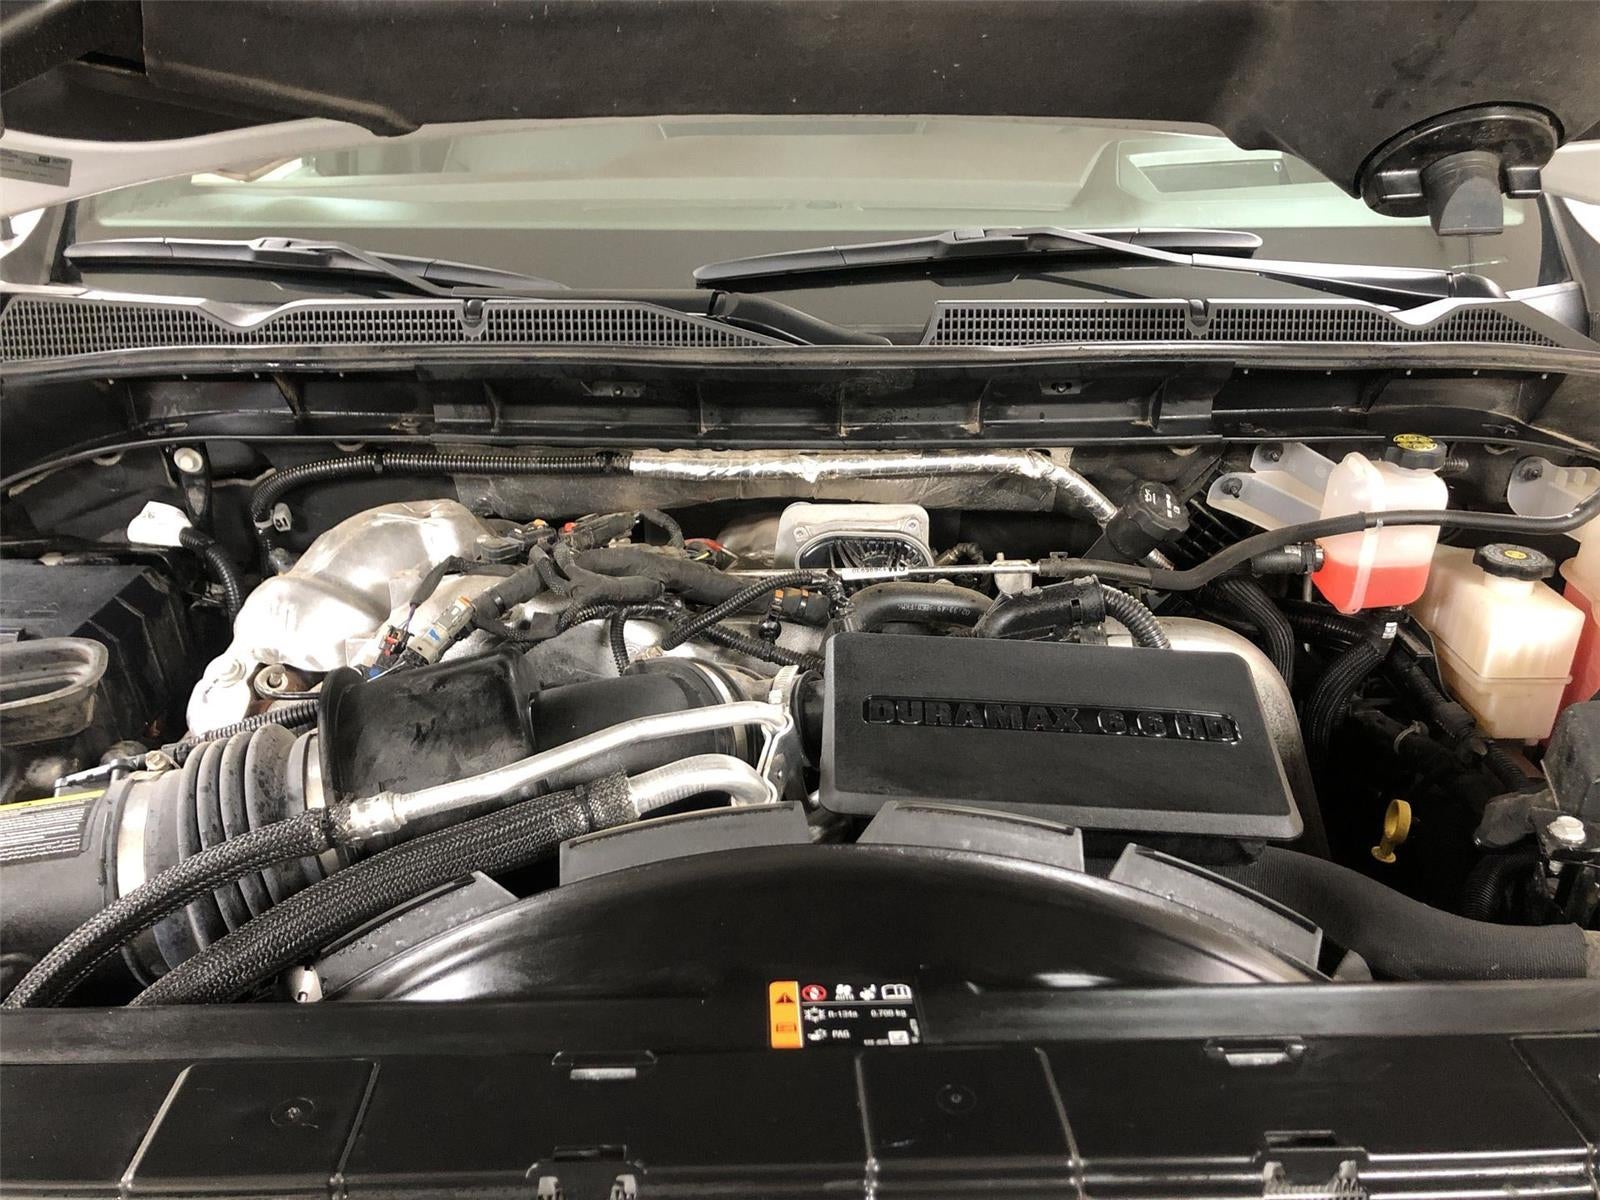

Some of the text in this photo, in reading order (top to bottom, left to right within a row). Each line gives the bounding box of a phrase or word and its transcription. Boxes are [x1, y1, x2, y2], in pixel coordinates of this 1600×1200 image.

[869, 698, 1238, 743] DURAMAX 6.6 HD
[831, 1029, 851, 1039] PAG
